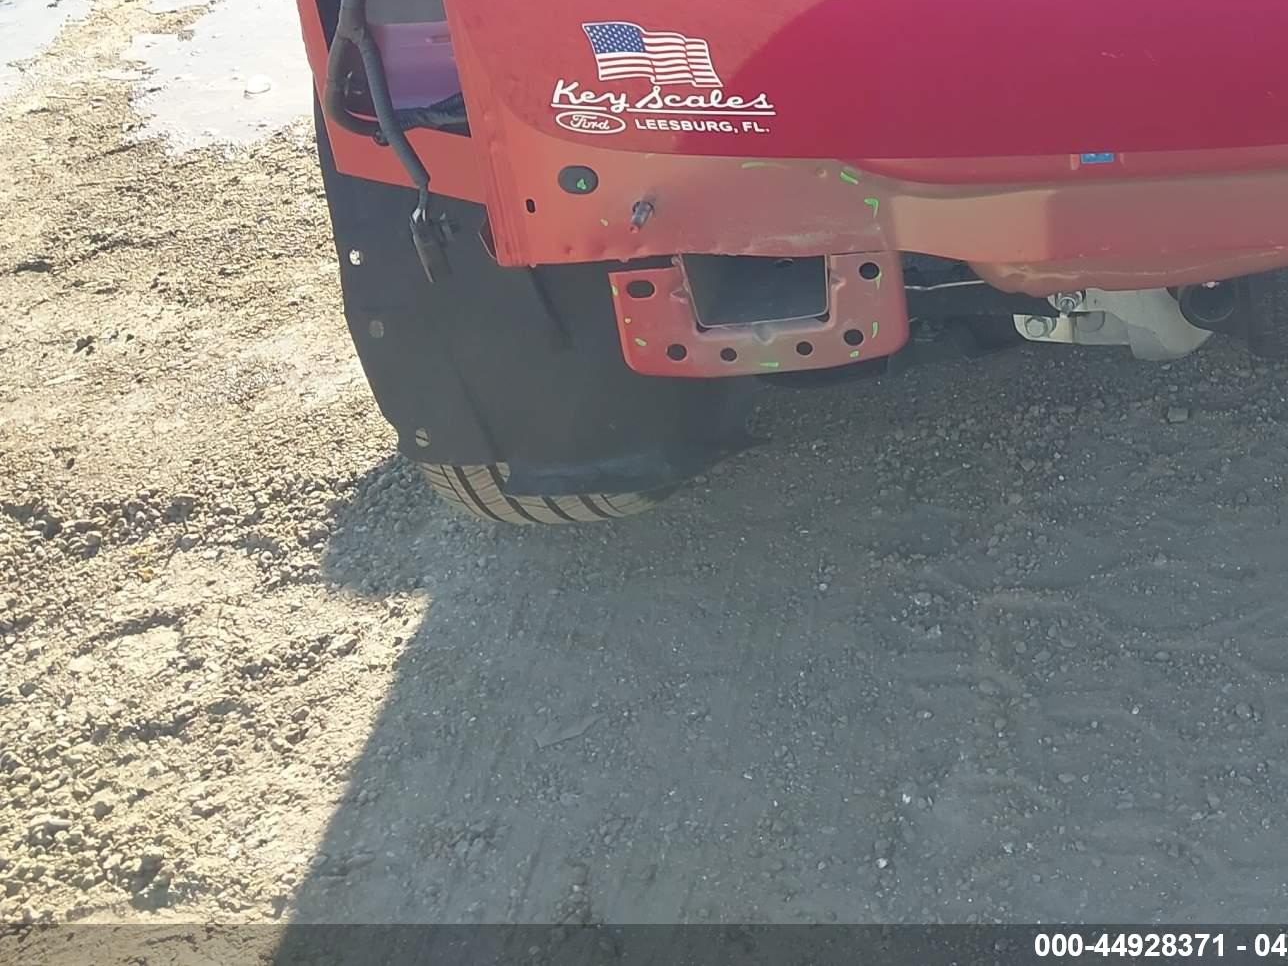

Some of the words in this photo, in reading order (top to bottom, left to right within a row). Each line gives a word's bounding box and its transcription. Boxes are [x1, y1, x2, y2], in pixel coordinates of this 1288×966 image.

[551, 79, 630, 113] Key
[635, 85, 775, 109] Scales
[569, 114, 611, 131] Ford
[634, 118, 740, 134] LEESBURG,
[742, 122, 771, 133] FL.
